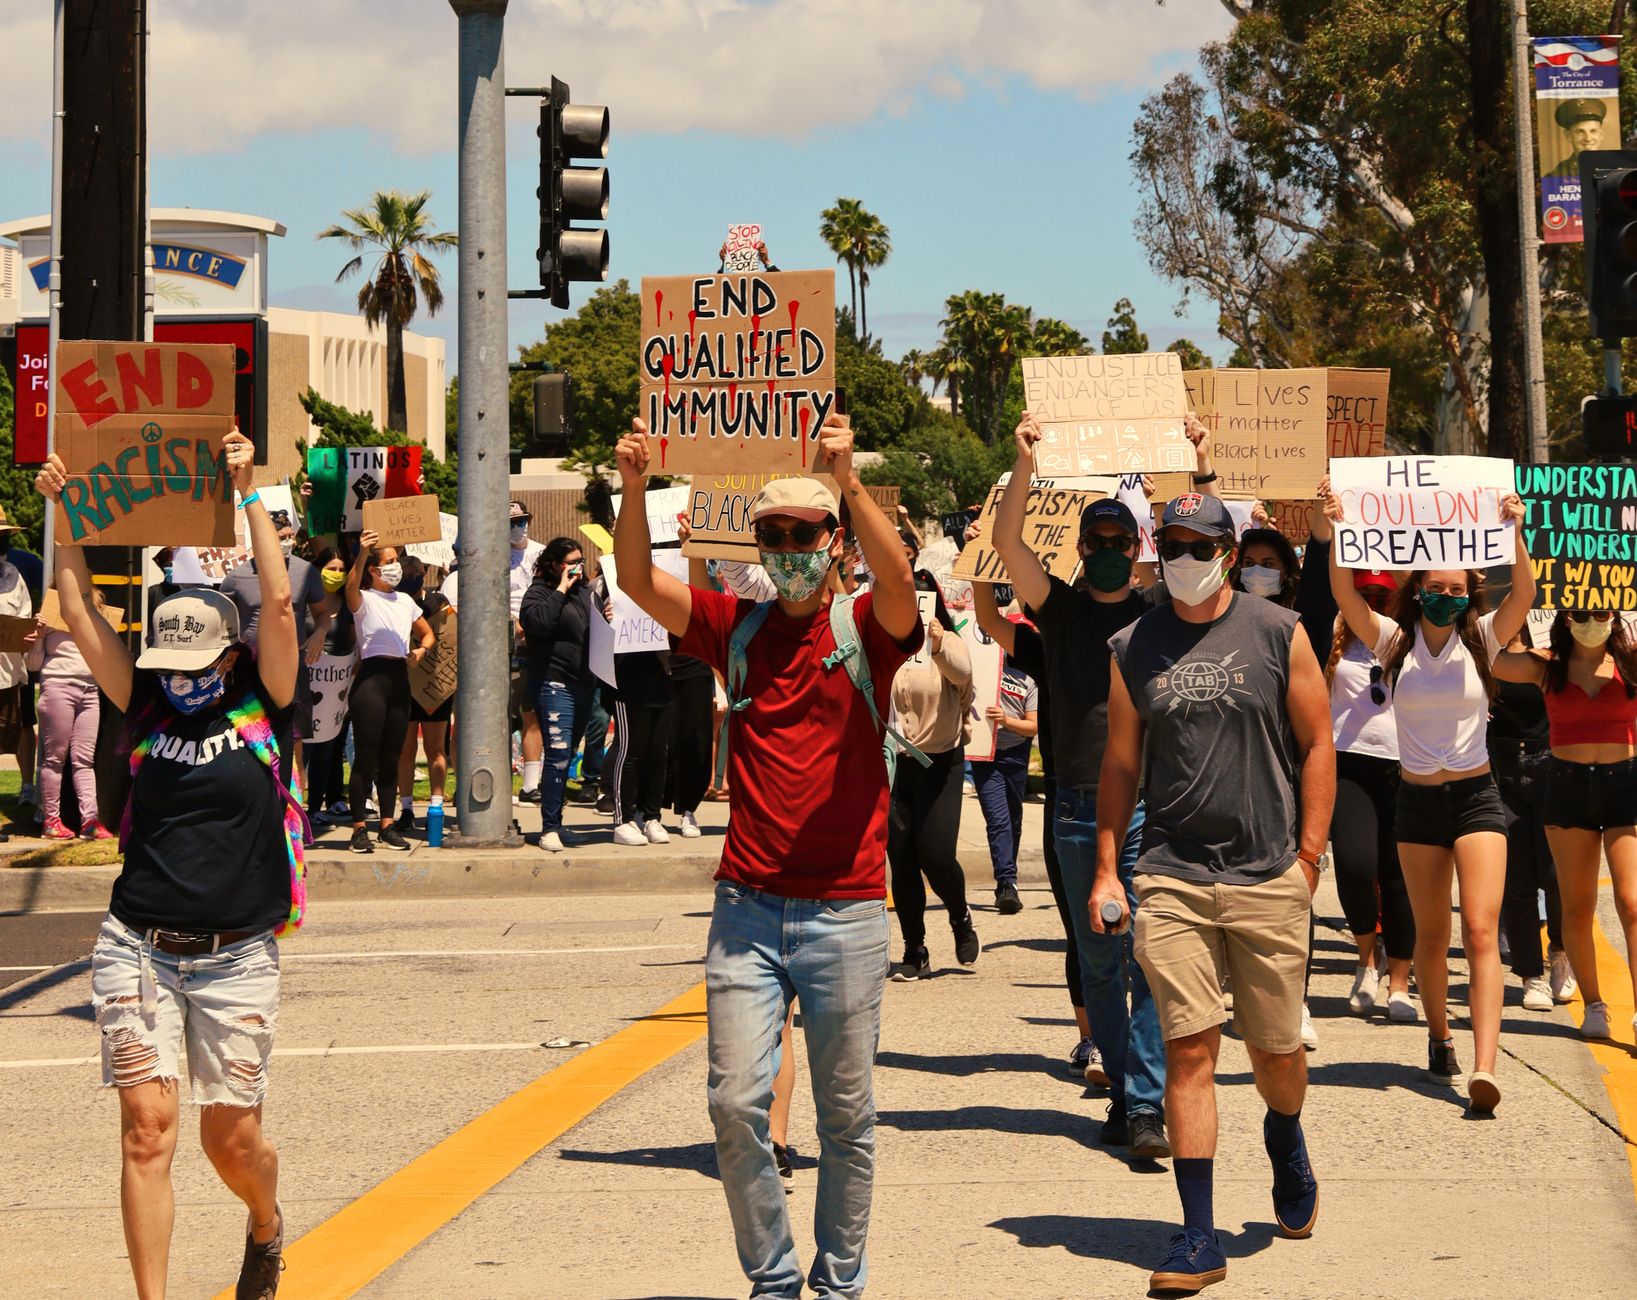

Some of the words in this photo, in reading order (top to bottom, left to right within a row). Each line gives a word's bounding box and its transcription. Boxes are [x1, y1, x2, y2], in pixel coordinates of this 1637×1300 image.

[1549, 75, 1604, 88] Torrance
[693, 277, 777, 320] END
[644, 328, 825, 381] QUALIFIED
[1024, 354, 1183, 379] INJUSTICE
[59, 348, 214, 429] END
[1026, 376, 1176, 401] ENDANGERS
[1235, 379, 1311, 406] Lives
[649, 388, 835, 442] IMMUNITY
[1034, 401, 1087, 420] ALL
[1096, 399, 1122, 417] OF
[1142, 399, 1176, 417] US
[1229, 415, 1303, 431] matter
[323, 451, 411, 470] LATINOS
[1213, 442, 1259, 459] Black
[1264, 444, 1306, 459] Lives
[1213, 471, 1270, 490] atter
[1387, 459, 1440, 487] HE
[384, 500, 417, 512] BLACK
[691, 490, 757, 534] BLACK
[987, 488, 1087, 517] RCISM
[1340, 486, 1508, 526] COULDN'T
[389, 514, 422, 526] LIVES
[1562, 501, 1618, 532] WILL
[385, 527, 425, 540] MATTER
[1033, 523, 1071, 547] THE
[1339, 528, 1504, 565] BREATHE
[974, 549, 1058, 579] VIS
[1598, 564, 1635, 588] YOU
[158, 614, 180, 634] South
[184, 615, 206, 638] Bay
[176, 633, 194, 643] Surf
[418, 640, 455, 676] LIVES
[1156, 677, 1167, 689] 20
[1185, 674, 1215, 688] TAB
[1233, 673, 1244, 684] 13
[147, 728, 245, 766] QUALITY.
